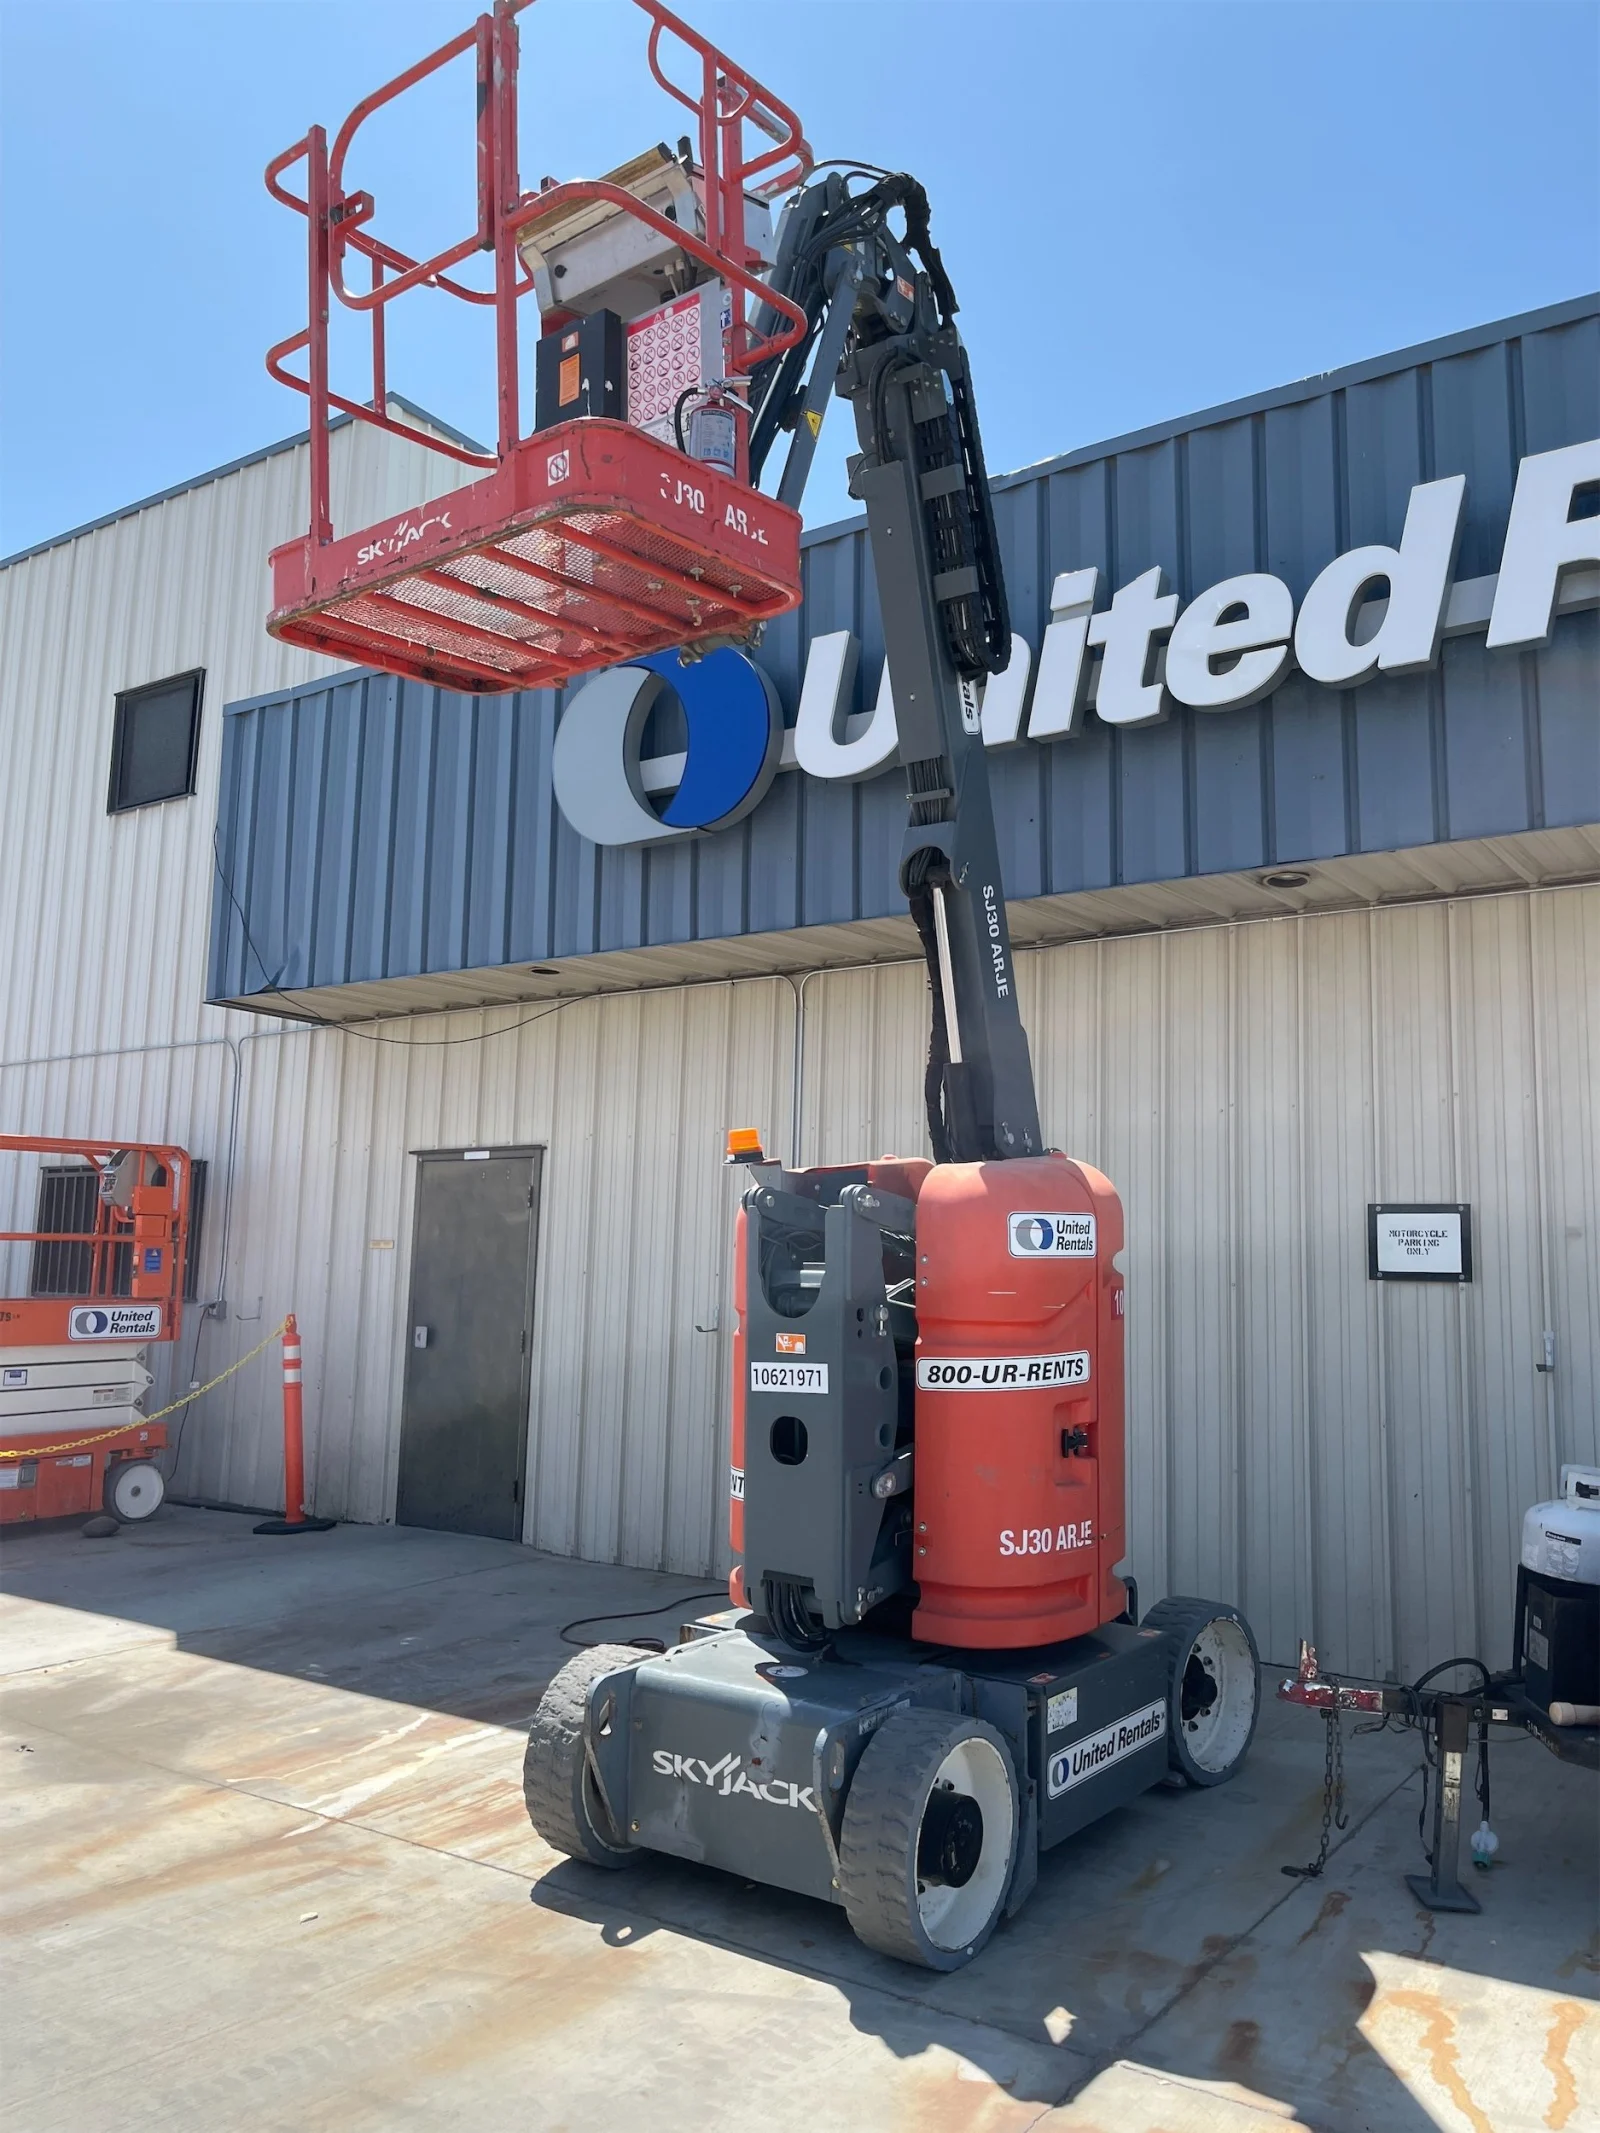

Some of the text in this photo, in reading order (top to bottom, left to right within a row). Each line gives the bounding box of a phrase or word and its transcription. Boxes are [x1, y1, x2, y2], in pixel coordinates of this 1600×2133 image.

[982, 884, 1009, 999] SJ30 ARJE
[1055, 1219, 1091, 1235] United
[1388, 1229, 1448, 1238] MOTORCYCLE
[1056, 1236, 1094, 1251] Rentals
[1397, 1238, 1440, 1247] PARKING
[1406, 1247, 1430, 1256] ONLY
[111, 1310, 153, 1322] United
[109, 1322, 156, 1334] Rentals
[753, 1368, 822, 1387] 10621971
[927, 1357, 1084, 1384] 800-UR-RENTS
[999, 1520, 1092, 1556] SJ30 ARJE
[1072, 1732, 1116, 1776] United
[1117, 1710, 1161, 1752] Rentals
[652, 1750, 818, 1813] SKYJACK
